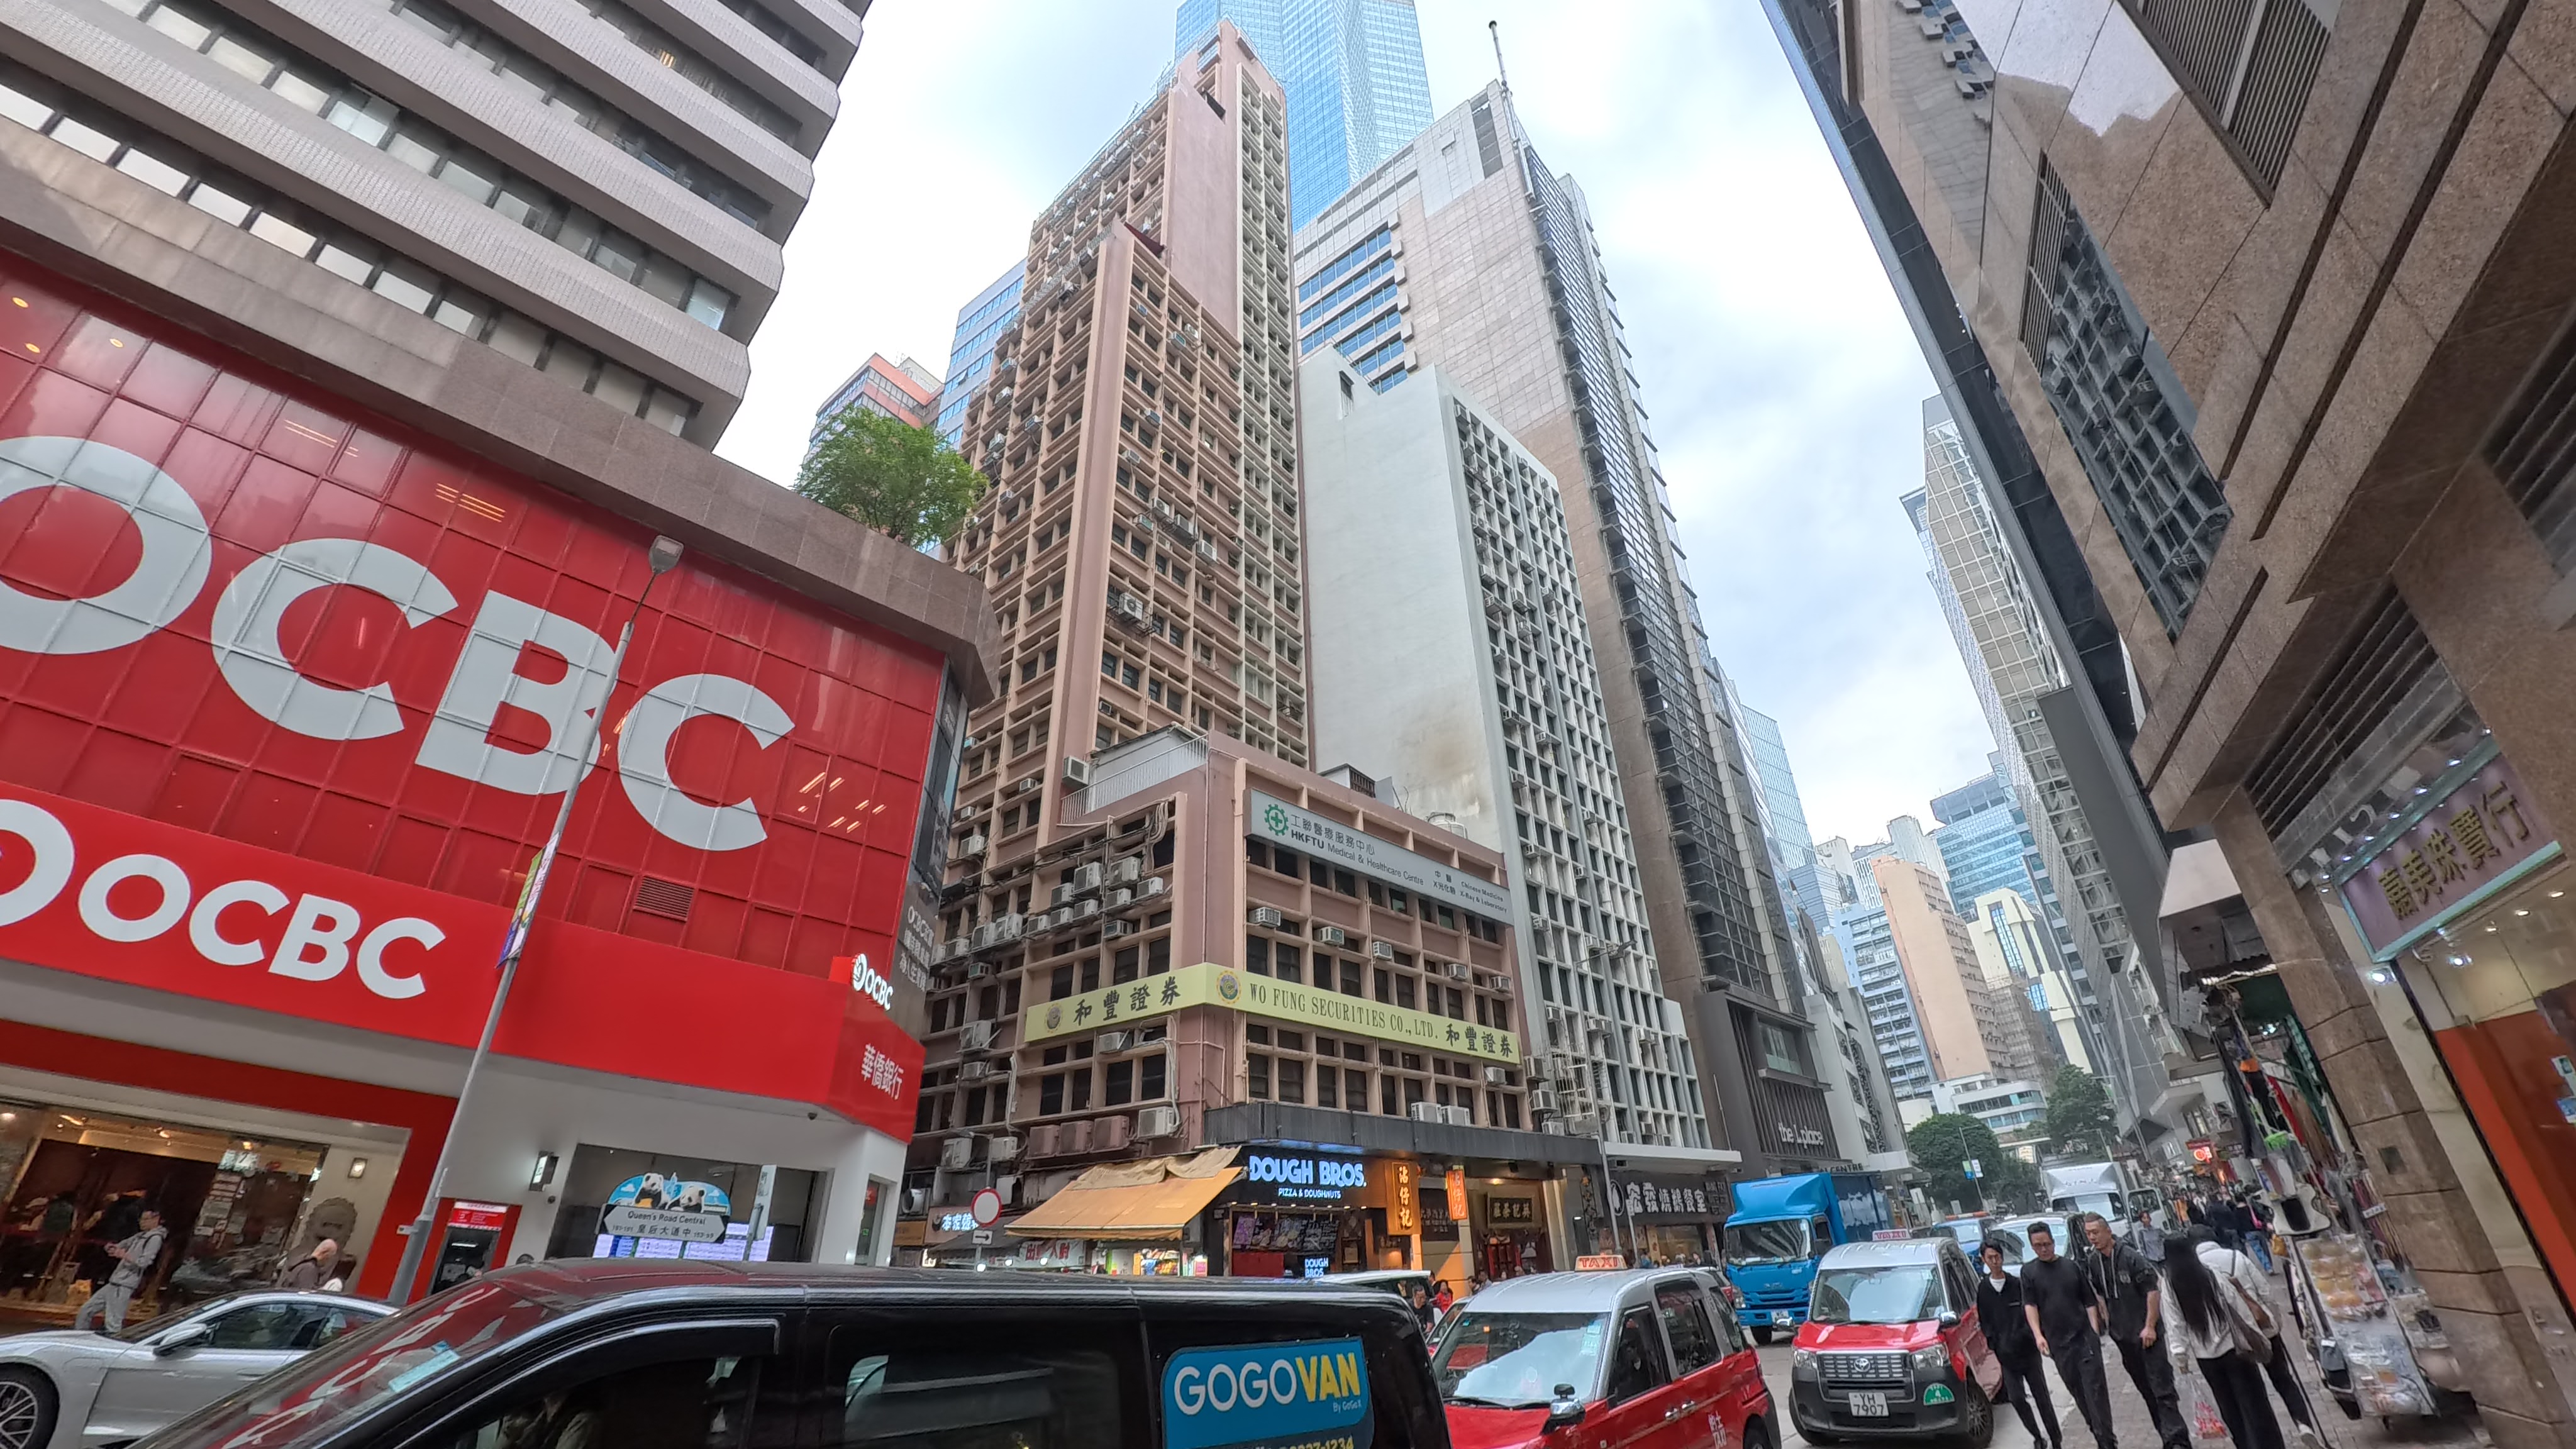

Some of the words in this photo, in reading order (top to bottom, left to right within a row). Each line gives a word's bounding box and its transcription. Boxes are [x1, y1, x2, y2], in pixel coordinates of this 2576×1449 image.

[0, 436, 796, 851] OCBC
[1291, 814, 1375, 856] 工聯醫療服務中心
[1291, 829, 1324, 849] HKFTU
[1328, 843, 1355, 861] Medical
[1358, 854, 1364, 864] &
[1367, 858, 1401, 877] Healthcare
[1403, 870, 1424, 886] Centre
[1460, 891, 1475, 903] X-Ray
[1481, 898, 1507, 914] Laboratory
[1461, 881, 1481, 894] Chinese
[1482, 889, 1504, 902] Medicine
[78, 853, 446, 999] OCBC
[864, 969, 893, 1011] OCBC
[1074, 976, 1181, 1026] 和豐證券
[1250, 982, 1267, 1004] WO
[1273, 987, 1306, 1013] FUNG
[1311, 996, 1386, 1030] SECURITIES
[1446, 1023, 1513, 1058] 和豐證券
[861, 1043, 904, 1100] 華僑銀行
[1249, 1155, 1313, 1184] DOUGH
[1319, 1160, 1367, 1187] BROS.
[1279, 1188, 1297, 1197] PIZZA
[1304, 1189, 1341, 1199] DOUGHNUTS
[1398, 1166, 1413, 1227] 沾仔記
[628, 1211, 657, 1222] Queen's
[659, 1214, 677, 1223] Road
[679, 1215, 706, 1225] Central
[636, 1224, 691, 1237] 皇后大道中
[1304, 1258, 1329, 1268] DOUGH
[1304, 1268, 1324, 1279] BROS
[1579, 1257, 1618, 1268] TAXI
[1174, 1352, 1360, 1415] GOGOVAN
[1860, 1394, 1875, 1405] YH
[1333, 1401, 1341, 1413] By
[1853, 1404, 1884, 1415] 7907
